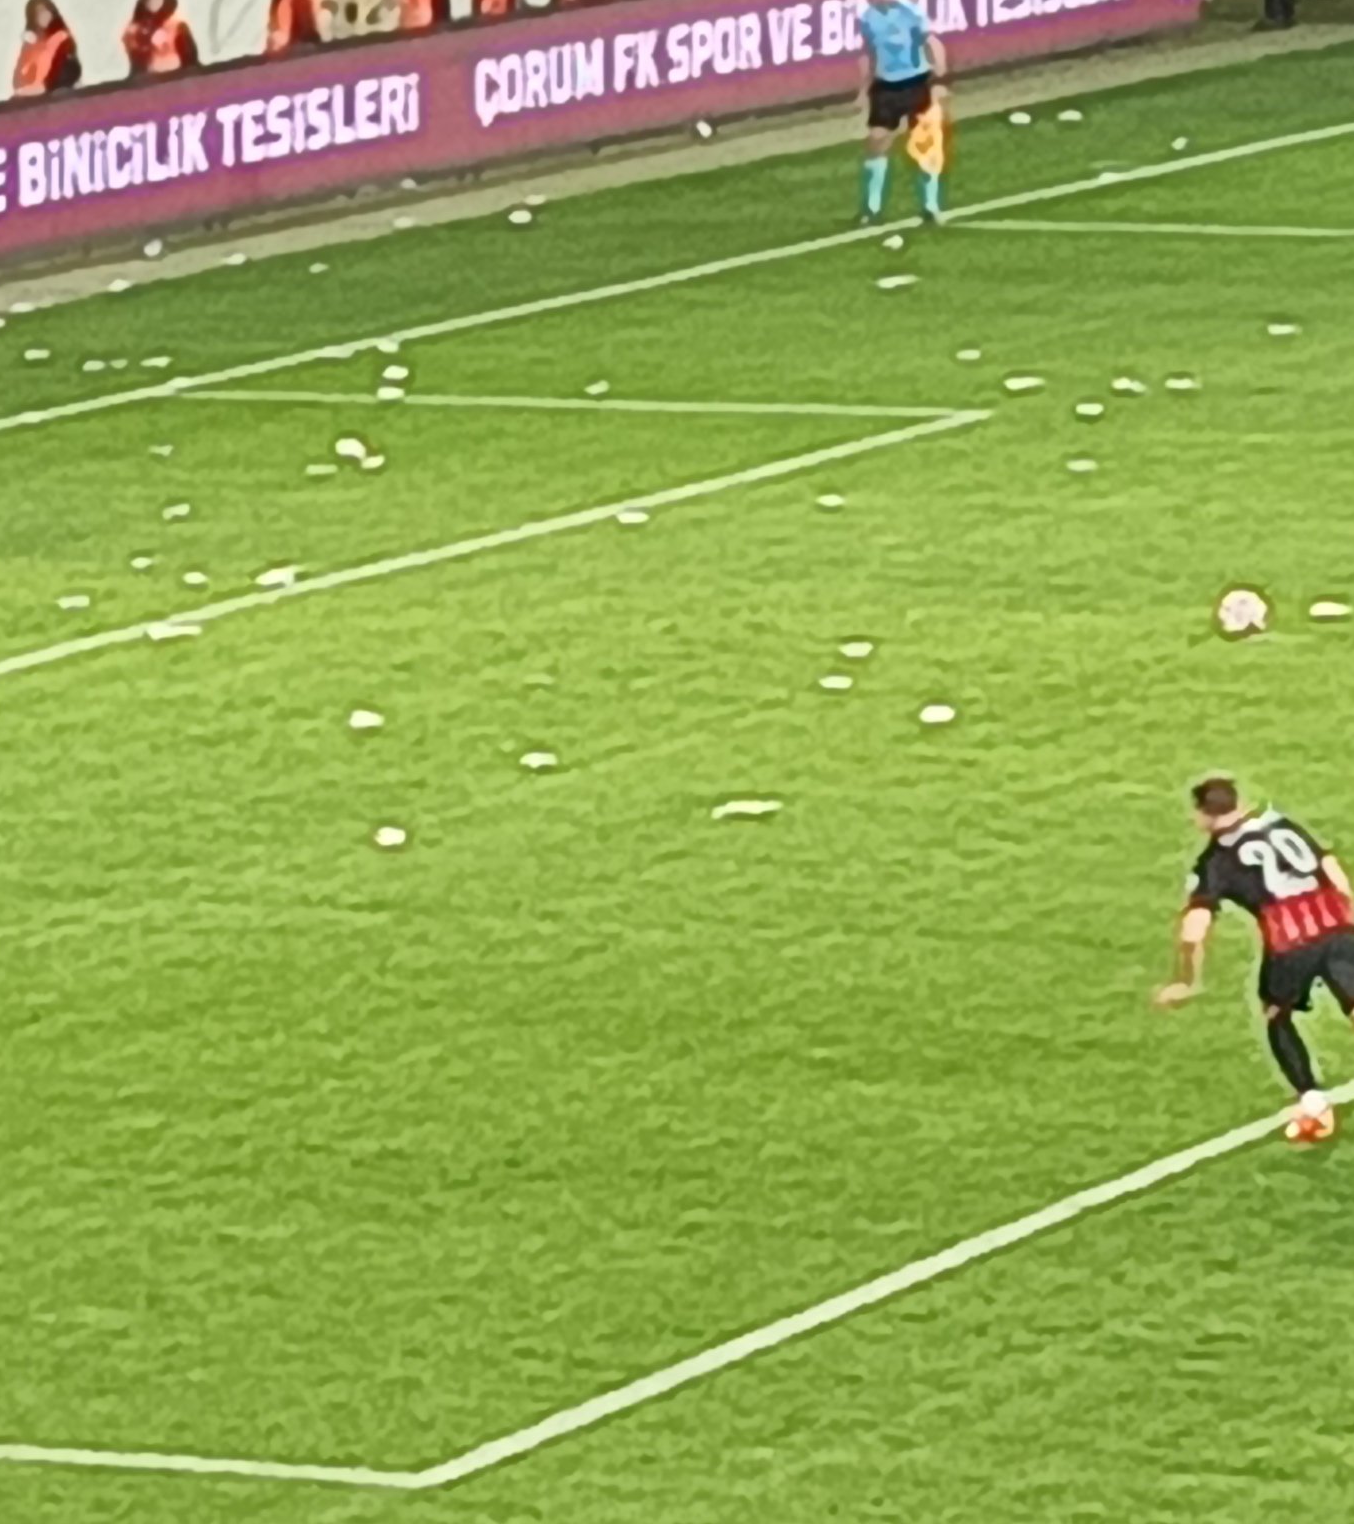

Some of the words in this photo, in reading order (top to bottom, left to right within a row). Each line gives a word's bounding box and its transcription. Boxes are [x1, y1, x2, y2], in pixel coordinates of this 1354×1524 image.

[474, 38, 604, 127] ÇORUM
[613, 30, 659, 92] FK
[667, 12, 762, 83] SPOR
[767, 4, 812, 65] VE
[1238, 829, 1319, 899] 20
